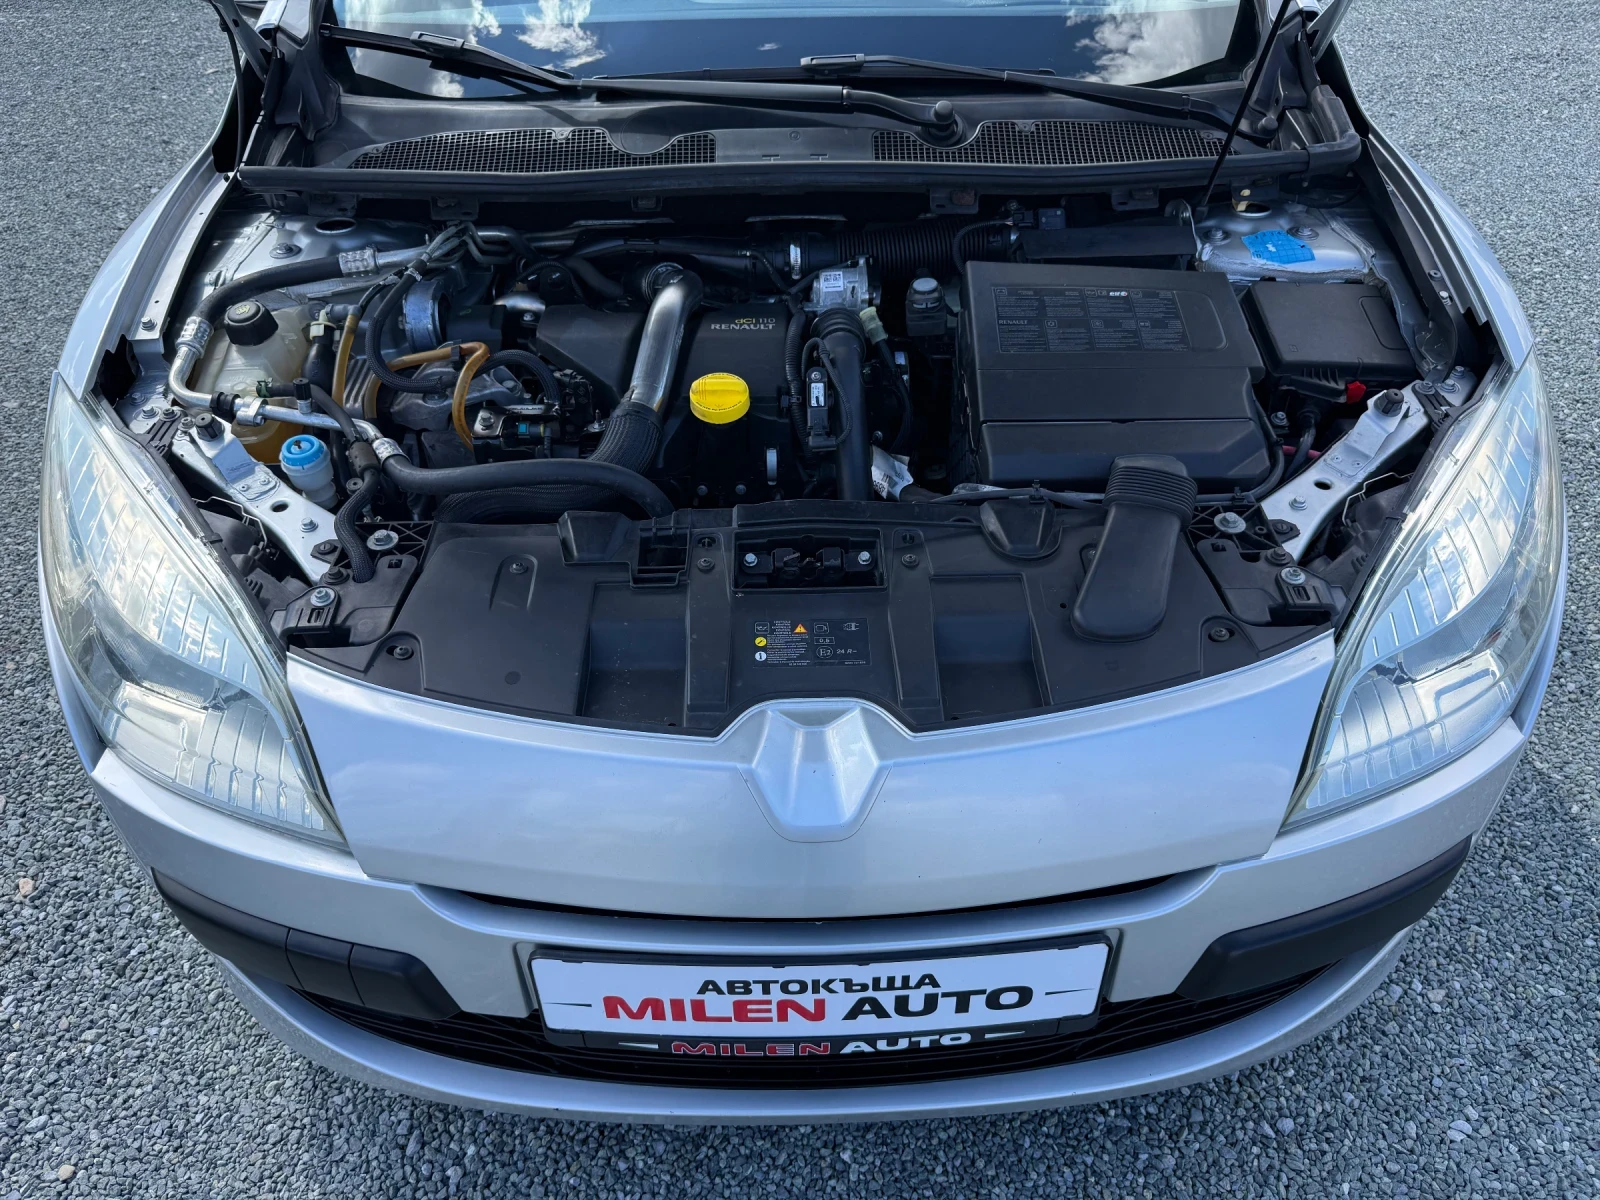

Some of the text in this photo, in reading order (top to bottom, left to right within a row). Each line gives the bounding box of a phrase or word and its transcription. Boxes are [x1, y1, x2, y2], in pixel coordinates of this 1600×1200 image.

[697, 973, 941, 994] АВТОКЪША
[602, 985, 1034, 1022] MILEN AUTO
[671, 1032, 972, 1057] MILEN AUTO
